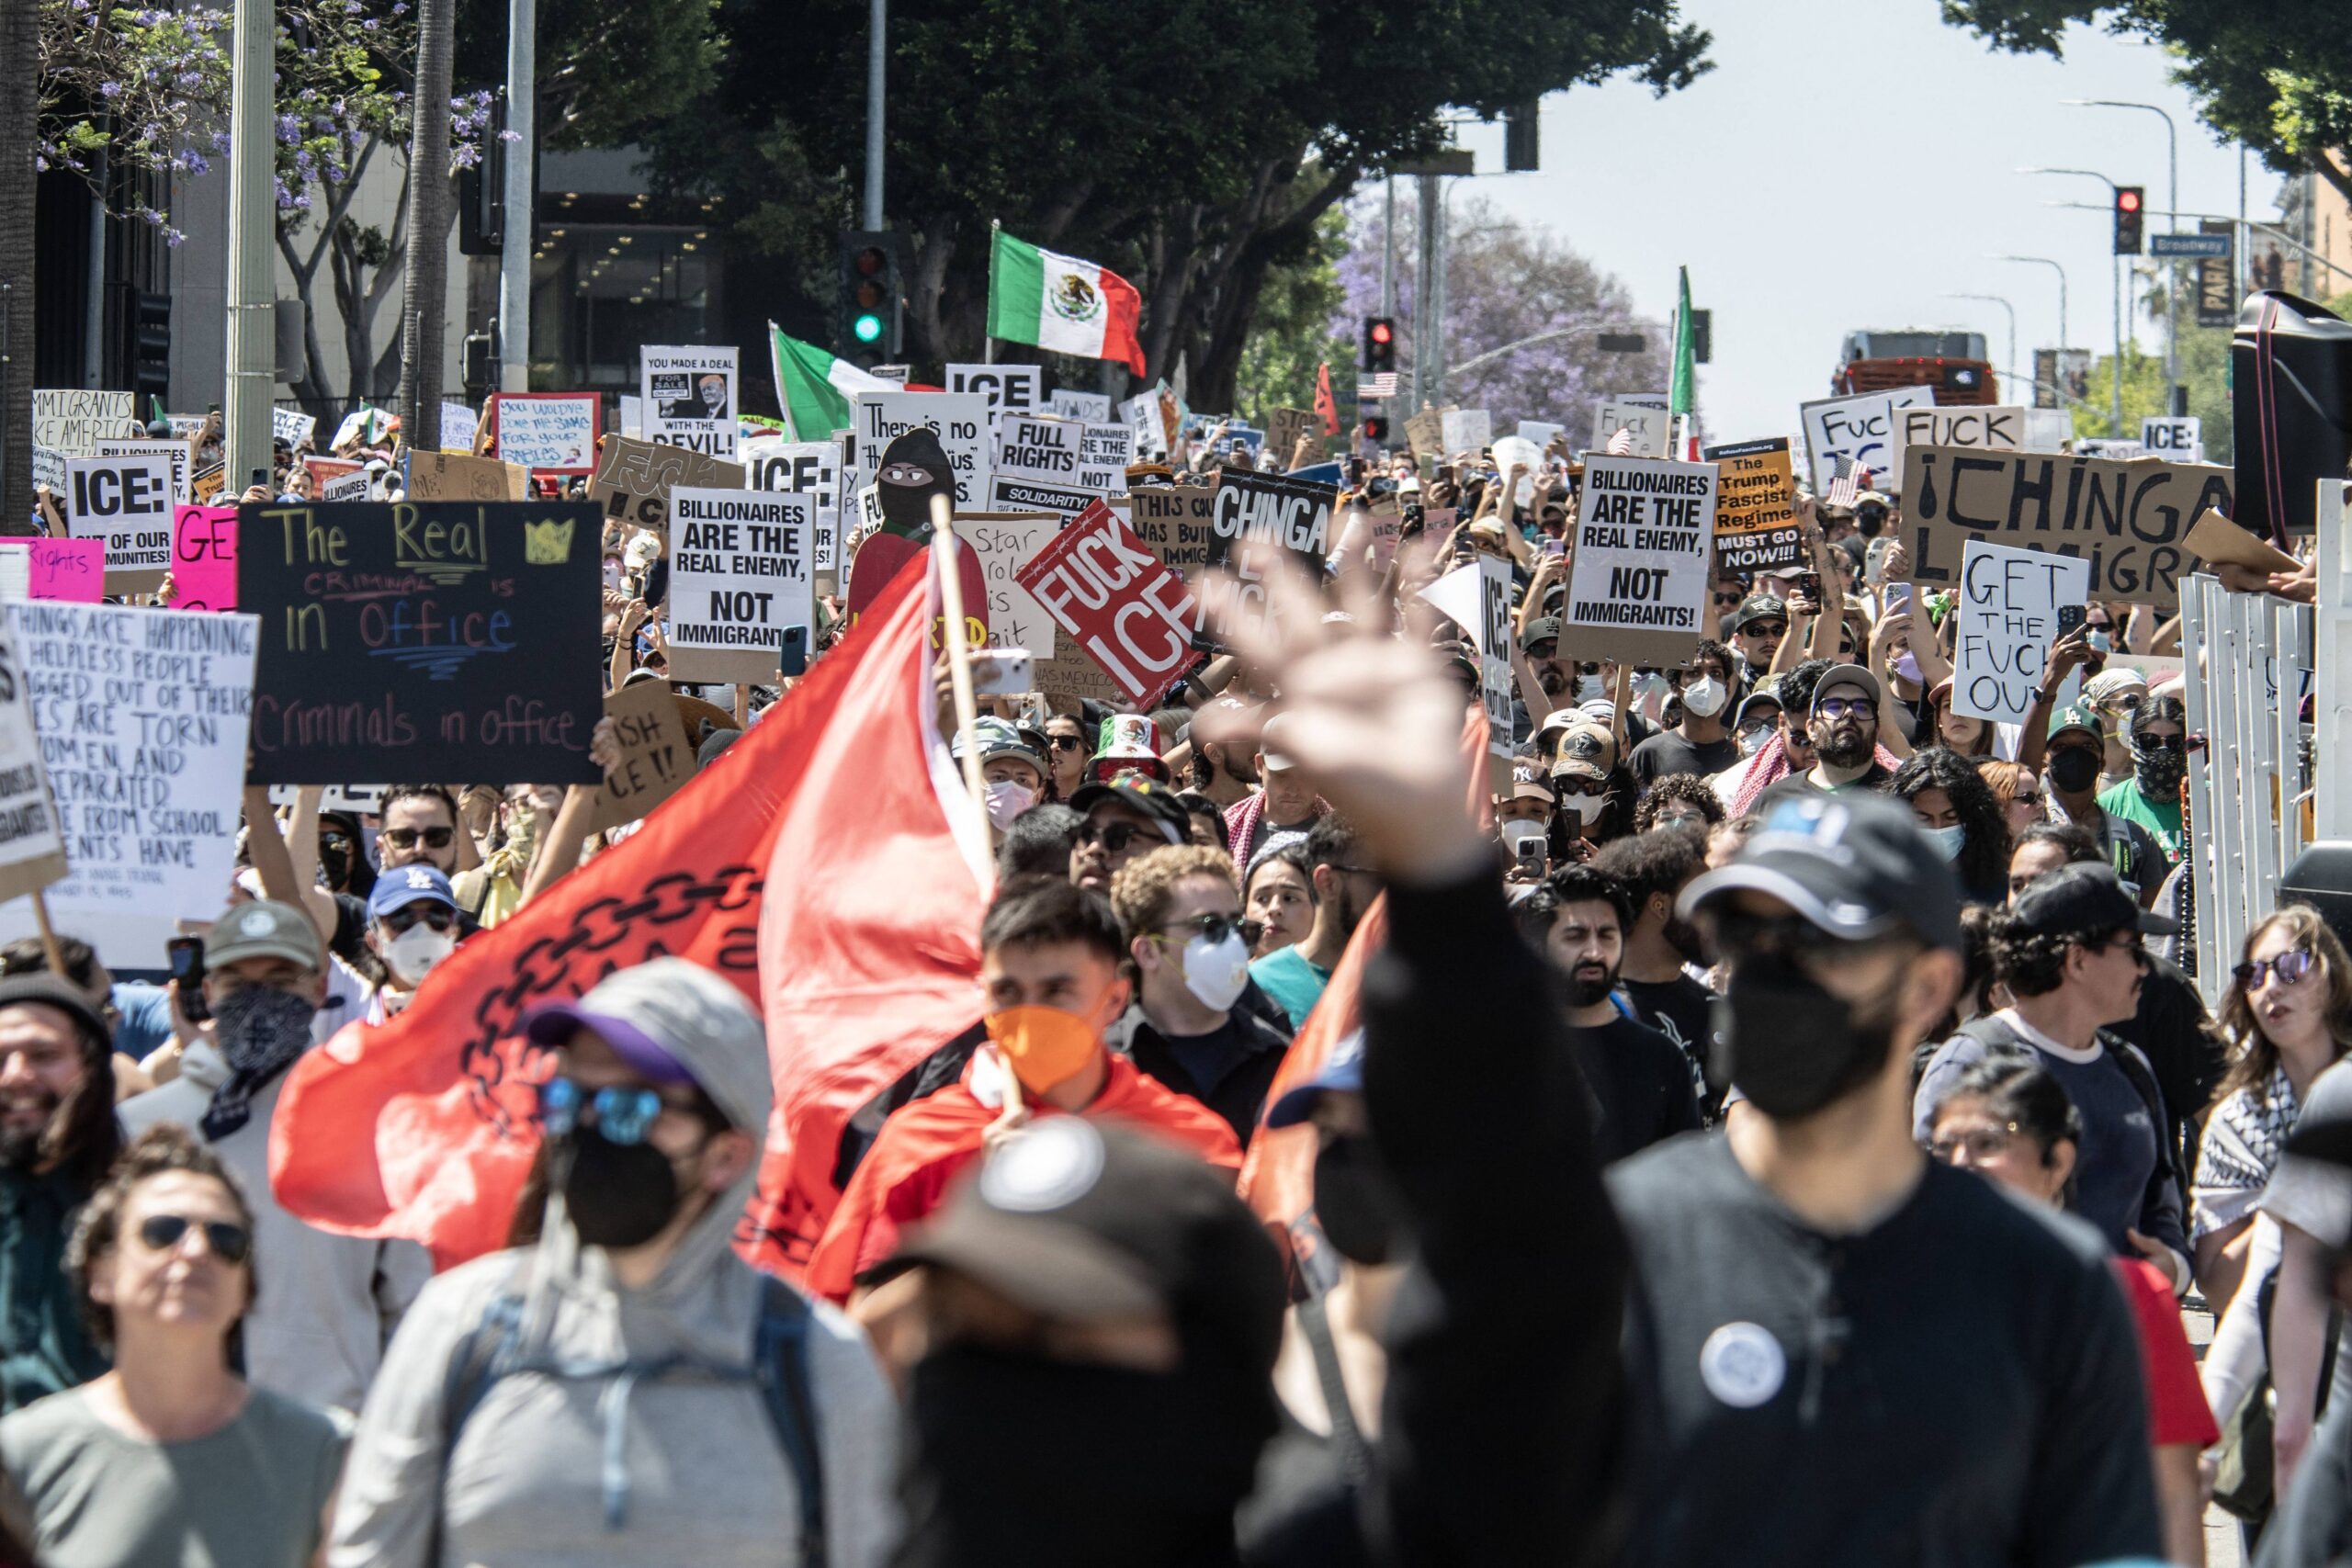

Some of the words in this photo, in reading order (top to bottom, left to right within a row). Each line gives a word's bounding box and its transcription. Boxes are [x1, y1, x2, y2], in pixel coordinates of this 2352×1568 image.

[2156, 239, 2223, 253] Broadway
[648, 358, 668, 368] YOU
[671, 358, 697, 368] MADE
[700, 359, 707, 368] A
[709, 359, 734, 368] DEAL
[654, 381, 686, 389] SALE
[954, 374, 1031, 407] ICE
[33, 391, 131, 418] MMIGRANTS
[664, 421, 692, 431] WITH
[696, 421, 715, 431] THE
[863, 402, 916, 438] Ther
[951, 421, 977, 439] no
[1276, 409, 1320, 429] STOP
[1905, 412, 2017, 446] FUCK
[33, 421, 54, 446] KE
[1018, 423, 1066, 448] FULL
[1081, 439, 1098, 452] RE
[1102, 440, 1127, 455] THE
[1082, 427, 1130, 440] LIONAIRES
[1280, 431, 1300, 448] IC
[2145, 423, 2192, 450] ICE:
[1001, 444, 1074, 472] RIGHTS
[1080, 455, 1091, 464] AL
[1732, 458, 1763, 471] The
[1823, 442, 1889, 486] IC
[73, 468, 164, 516] ICE:
[204, 481, 224, 493] Tru
[752, 457, 831, 507] ICE:
[1080, 470, 1113, 488] NOT
[1590, 469, 1709, 496] BILLIONAIRES
[1720, 473, 1781, 491] Trump
[607, 491, 669, 527] I.C.
[678, 499, 805, 525] BILLIONAIRES
[1009, 488, 1090, 510] SOLIDARITY!
[1132, 493, 1183, 518] THIS
[1191, 497, 1215, 518] COU
[1590, 493, 1645, 525] ARE
[1653, 497, 1702, 529] THE
[1716, 490, 1789, 509] Fascist
[1214, 486, 1329, 555] CHINGA
[1716, 509, 1792, 529] Regime
[110, 533, 132, 550] OF
[136, 531, 170, 548] OUR
[177, 510, 238, 563] GE
[260, 508, 351, 566] The
[392, 503, 488, 563] Real
[682, 523, 739, 551] ARE
[747, 525, 799, 556] THE
[975, 527, 1038, 553] Star
[1582, 525, 1629, 549] REAL
[1634, 528, 1703, 558] ENEMY,
[1717, 534, 1768, 550] MUST
[1771, 529, 1798, 544] GO
[25, 540, 89, 582] Rights
[104, 550, 171, 566] MUNITIES!
[676, 553, 727, 574] REAL
[732, 555, 807, 582] ENEMY,
[1163, 547, 1206, 565] IMMIG
[1725, 544, 1795, 568] NOW!!!
[304, 571, 435, 595] CRIMINAL
[1032, 514, 1156, 636] FUCK
[1609, 566, 1669, 602] NOT
[1966, 553, 2069, 611] GET
[710, 591, 774, 624] NOT
[988, 590, 1011, 612] is
[1574, 602, 1695, 627] IMMIGRANTS!
[84, 613, 134, 645] ARE
[144, 616, 254, 656] HAPPENING
[677, 623, 782, 648] IMMIGRANT
[1087, 570, 1195, 697] ICE
[1978, 613, 2046, 639] THE
[29, 639, 124, 673] HELPLESS
[132, 650, 212, 686] PEOPLE
[103, 676, 144, 705] OUT
[156, 684, 181, 710] OF
[191, 685, 252, 718] THEIR
[1969, 675, 2038, 714] OU
[71, 701, 117, 735] ARE
[130, 711, 219, 748] TORN
[132, 748, 186, 775] AND
[84, 805, 140, 835] FROM
[148, 808, 228, 838] SCHOOL
[63, 835, 123, 862] ENTS
[139, 838, 197, 869] HAVE
